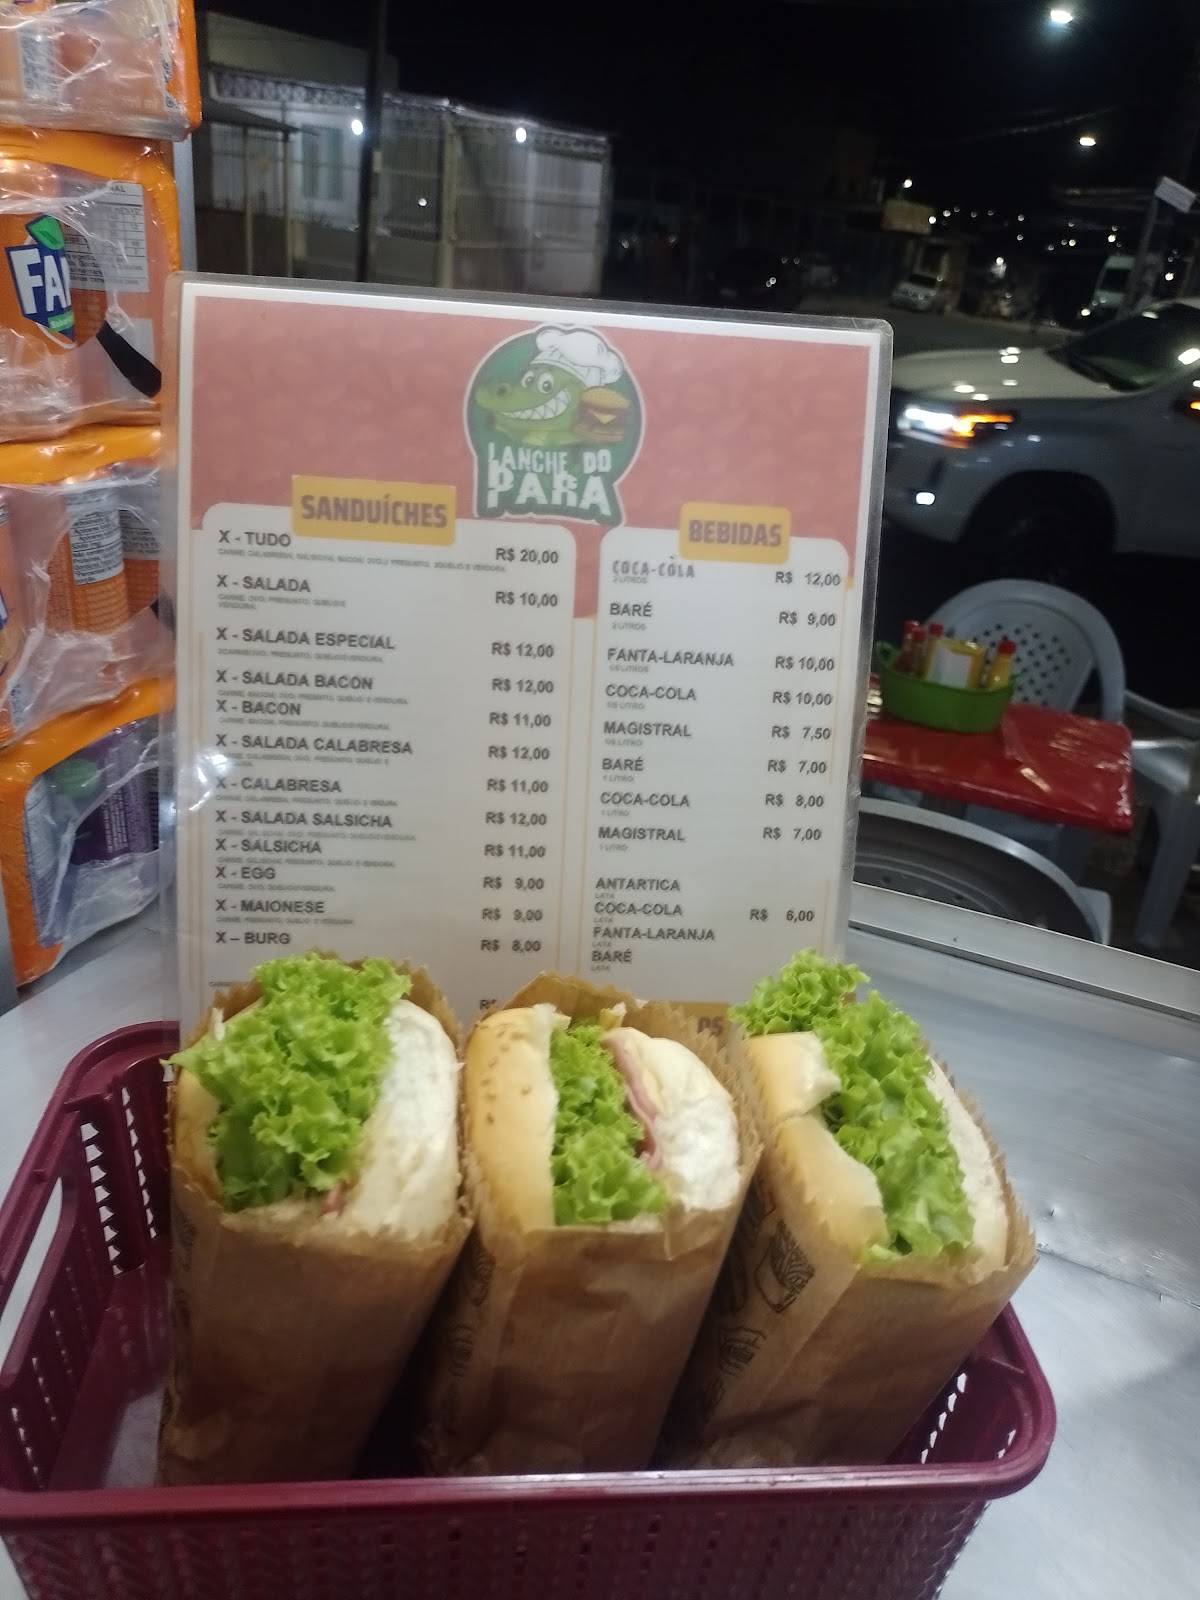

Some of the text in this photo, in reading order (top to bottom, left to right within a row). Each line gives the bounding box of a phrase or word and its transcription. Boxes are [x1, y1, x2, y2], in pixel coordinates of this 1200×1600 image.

[489, 441, 612, 474] LANCHE DO
[487, 460, 612, 516] PARA
[300, 493, 449, 529] SANDUÍCHES
[218, 529, 231, 544] X
[243, 531, 292, 548] TUDO
[688, 519, 783, 548] BEBIDAS
[495, 547, 516, 563] R$
[519, 548, 560, 565] 20,00
[216, 574, 229, 588] X
[242, 575, 312, 593] SALADA
[775, 570, 842, 588] R$ 12,00
[495, 590, 559, 609] R$ 10,00
[609, 601, 653, 618] BARÉ
[778, 610, 837, 629] R$ 9,00
[215, 626, 228, 641] X
[241, 627, 311, 646] SALADA
[314, 632, 396, 650] ESPECIAL
[491, 641, 555, 659] R$ 12,00
[607, 647, 735, 667] FANTA-LARANJA
[774, 655, 835, 673] R$ 10,00
[215, 669, 228, 683] X
[241, 670, 310, 687] SALADA
[314, 673, 374, 691] BACON
[491, 677, 555, 695] R$ 12,00
[604, 683, 697, 701] COCA-COLA
[772, 690, 833, 708] R$ 10,00
[215, 699, 228, 713] X
[241, 699, 302, 716] BACON
[489, 711, 552, 729] R$ 11,00
[603, 720, 692, 738] MAGISTRAL
[771, 724, 832, 741] R$ 7,50
[215, 733, 228, 748] X
[241, 734, 310, 751] SALADA
[312, 737, 413, 755] CALABRESA
[487, 745, 551, 762] R$ 12,00
[601, 755, 644, 772] BARÉ
[767, 759, 828, 776] R$ 7,00
[215, 776, 227, 790] X
[240, 776, 343, 793] CALABRESA
[486, 778, 550, 795] R$ 11,00
[599, 791, 691, 808] COCA-COLA
[764, 793, 825, 809] R$ 8,00
[215, 809, 227, 824] X
[240, 810, 308, 825] SALADA
[311, 812, 393, 828] SALSICHA
[485, 811, 548, 828] R$ 12,00
[597, 826, 686, 842] MAGISTRAL
[762, 826, 823, 842] R$ 7,00
[215, 837, 227, 852] X
[240, 838, 323, 854] SALSICHA
[483, 843, 547, 860] R$ 11,00
[215, 865, 227, 879] X
[240, 866, 277, 880] EGG
[482, 875, 545, 891] R$ 9,00
[595, 877, 681, 892] ANTARTICA
[215, 898, 227, 912] X
[240, 899, 325, 914] MAIONESE
[594, 900, 683, 917] COCA-COLA
[481, 907, 544, 923] R$ 9,00
[749, 908, 816, 924] R$ 6,00
[215, 931, 227, 944] X
[243, 931, 292, 945] BURG
[593, 926, 716, 941] FANTA-LARANJA
[480, 938, 542, 954] R$ 8,00
[591, 948, 633, 964] BARÉ
